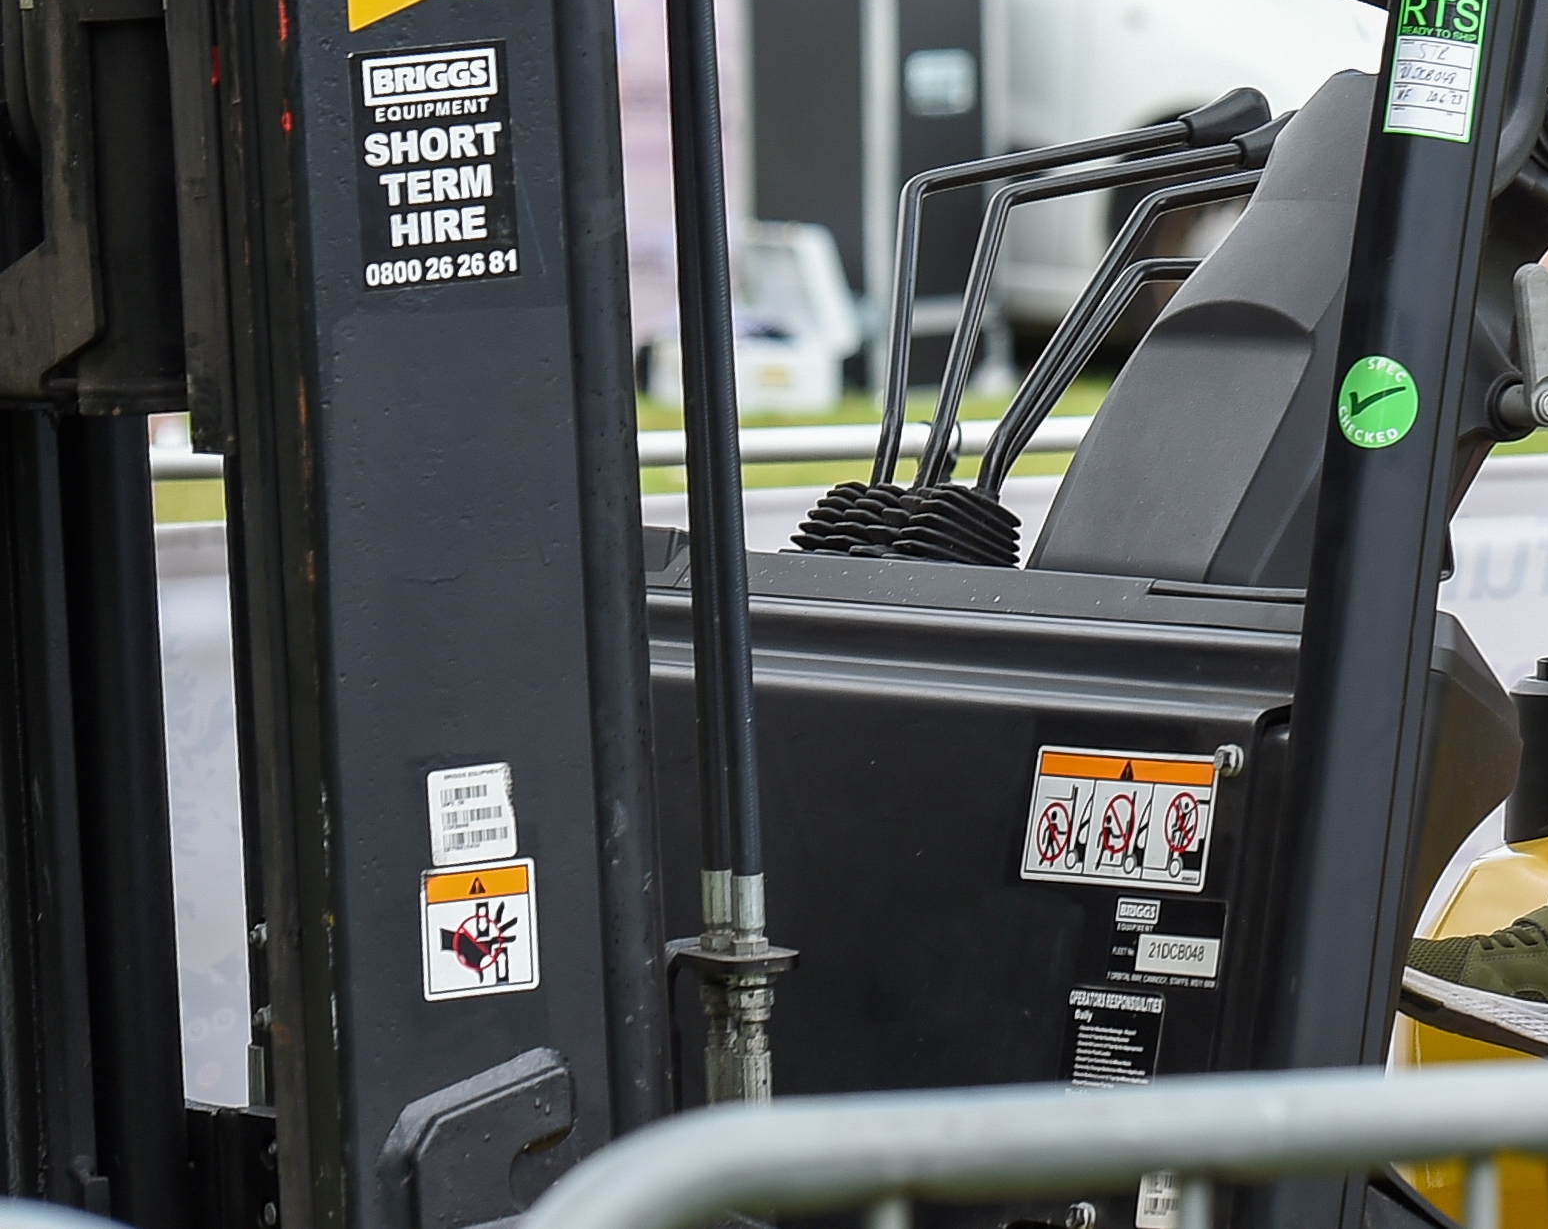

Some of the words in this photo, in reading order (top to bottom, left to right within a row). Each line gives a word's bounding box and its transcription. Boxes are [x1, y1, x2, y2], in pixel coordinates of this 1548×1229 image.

[1435, 28, 1451, 38] TO
[372, 59, 488, 95] BRIGGS
[374, 97, 490, 123] EQUIPMENT
[364, 121, 502, 167] SHORT
[379, 163, 493, 207] TERM
[390, 205, 488, 248] HIRE
[365, 258, 422, 286] 0800
[425, 256, 454, 281] 26
[457, 253, 485, 277] 26
[488, 249, 518, 274] 81
[1367, 358, 1408, 383] SPEC
[1339, 405, 1398, 443] CHECKED
[1119, 903, 1157, 919] BRIGGS
[1148, 941, 1206, 962] 21DCB048
